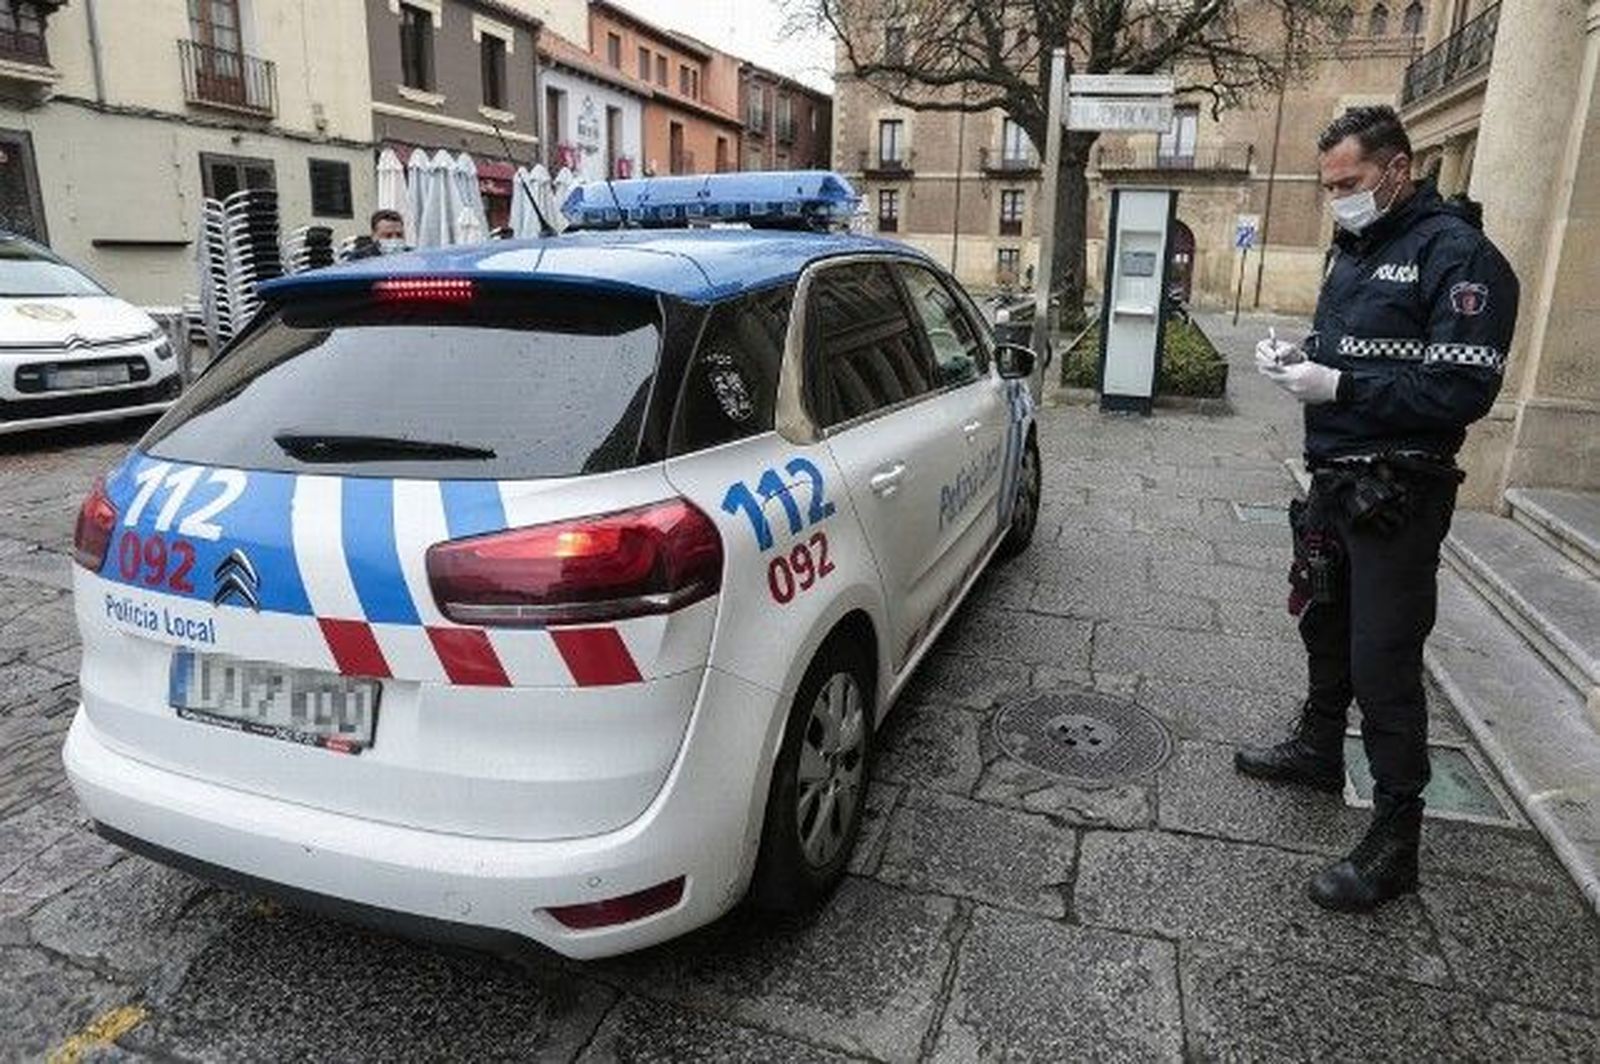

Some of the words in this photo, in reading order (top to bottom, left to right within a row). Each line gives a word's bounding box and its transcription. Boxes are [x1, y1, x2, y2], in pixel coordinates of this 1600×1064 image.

[124, 463, 248, 541] 112
[721, 457, 837, 552] 112
[119, 531, 196, 593] 092
[768, 532, 836, 604] 092
[164, 607, 216, 644] Local
